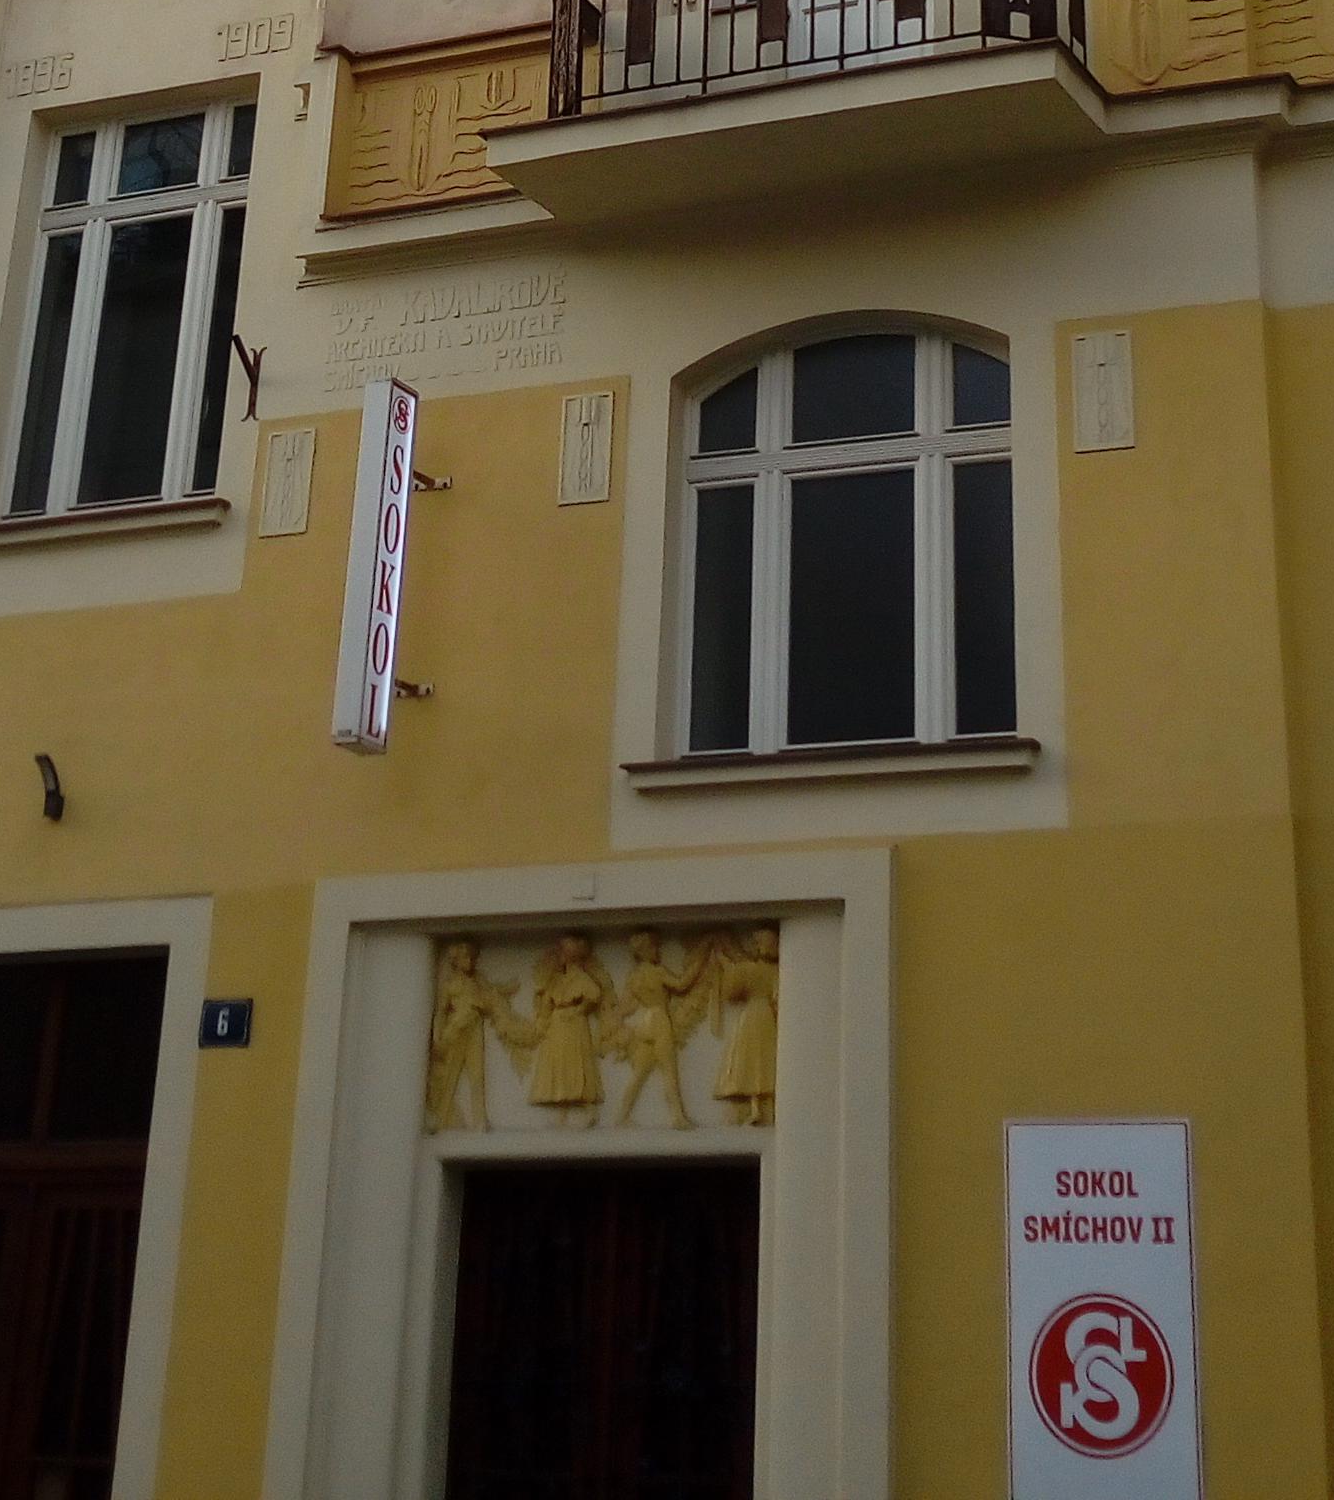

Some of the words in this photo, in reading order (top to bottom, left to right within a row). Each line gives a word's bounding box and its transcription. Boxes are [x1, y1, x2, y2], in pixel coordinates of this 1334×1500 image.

[217, 13, 294, 62] 1909
[367, 443, 404, 738] SOKOL
[217, 1007, 230, 1037] 6
[1055, 1170, 1140, 1199] SOKOL
[1023, 1211, 1144, 1245] SMÍCHOV
[1151, 1215, 1176, 1245] II
